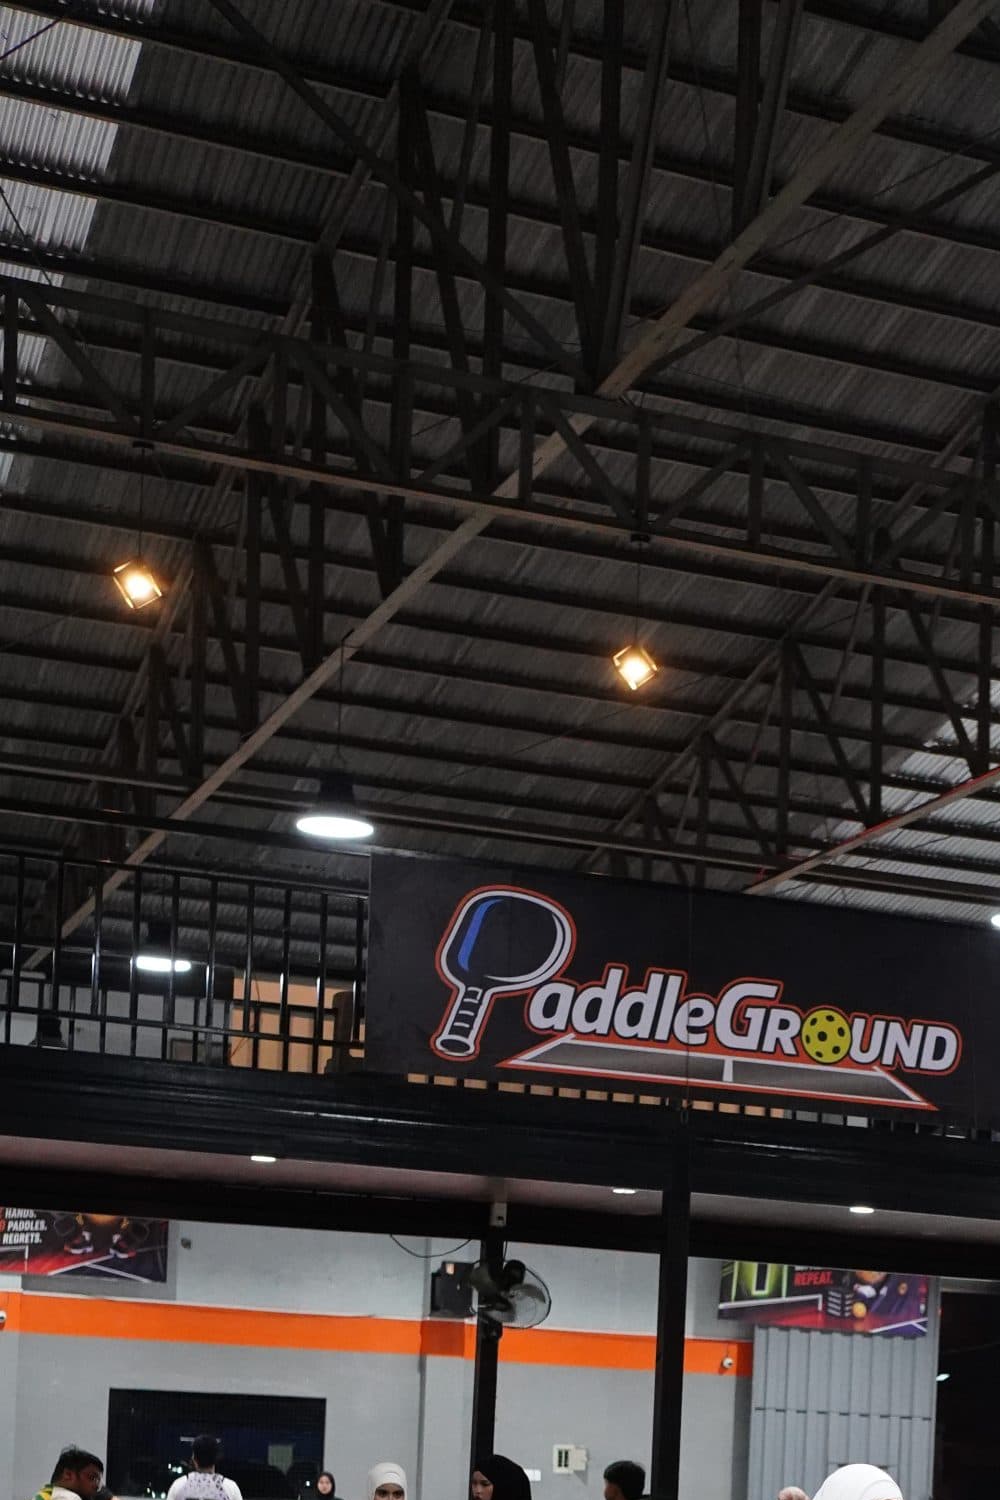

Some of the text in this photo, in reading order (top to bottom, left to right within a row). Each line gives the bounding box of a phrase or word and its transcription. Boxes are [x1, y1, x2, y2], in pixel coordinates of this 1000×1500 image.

[7, 1219, 47, 1231] PADDLES.
[2, 1232, 42, 1245] REGRETS.
[793, 1271, 834, 1287] REPEAT.
